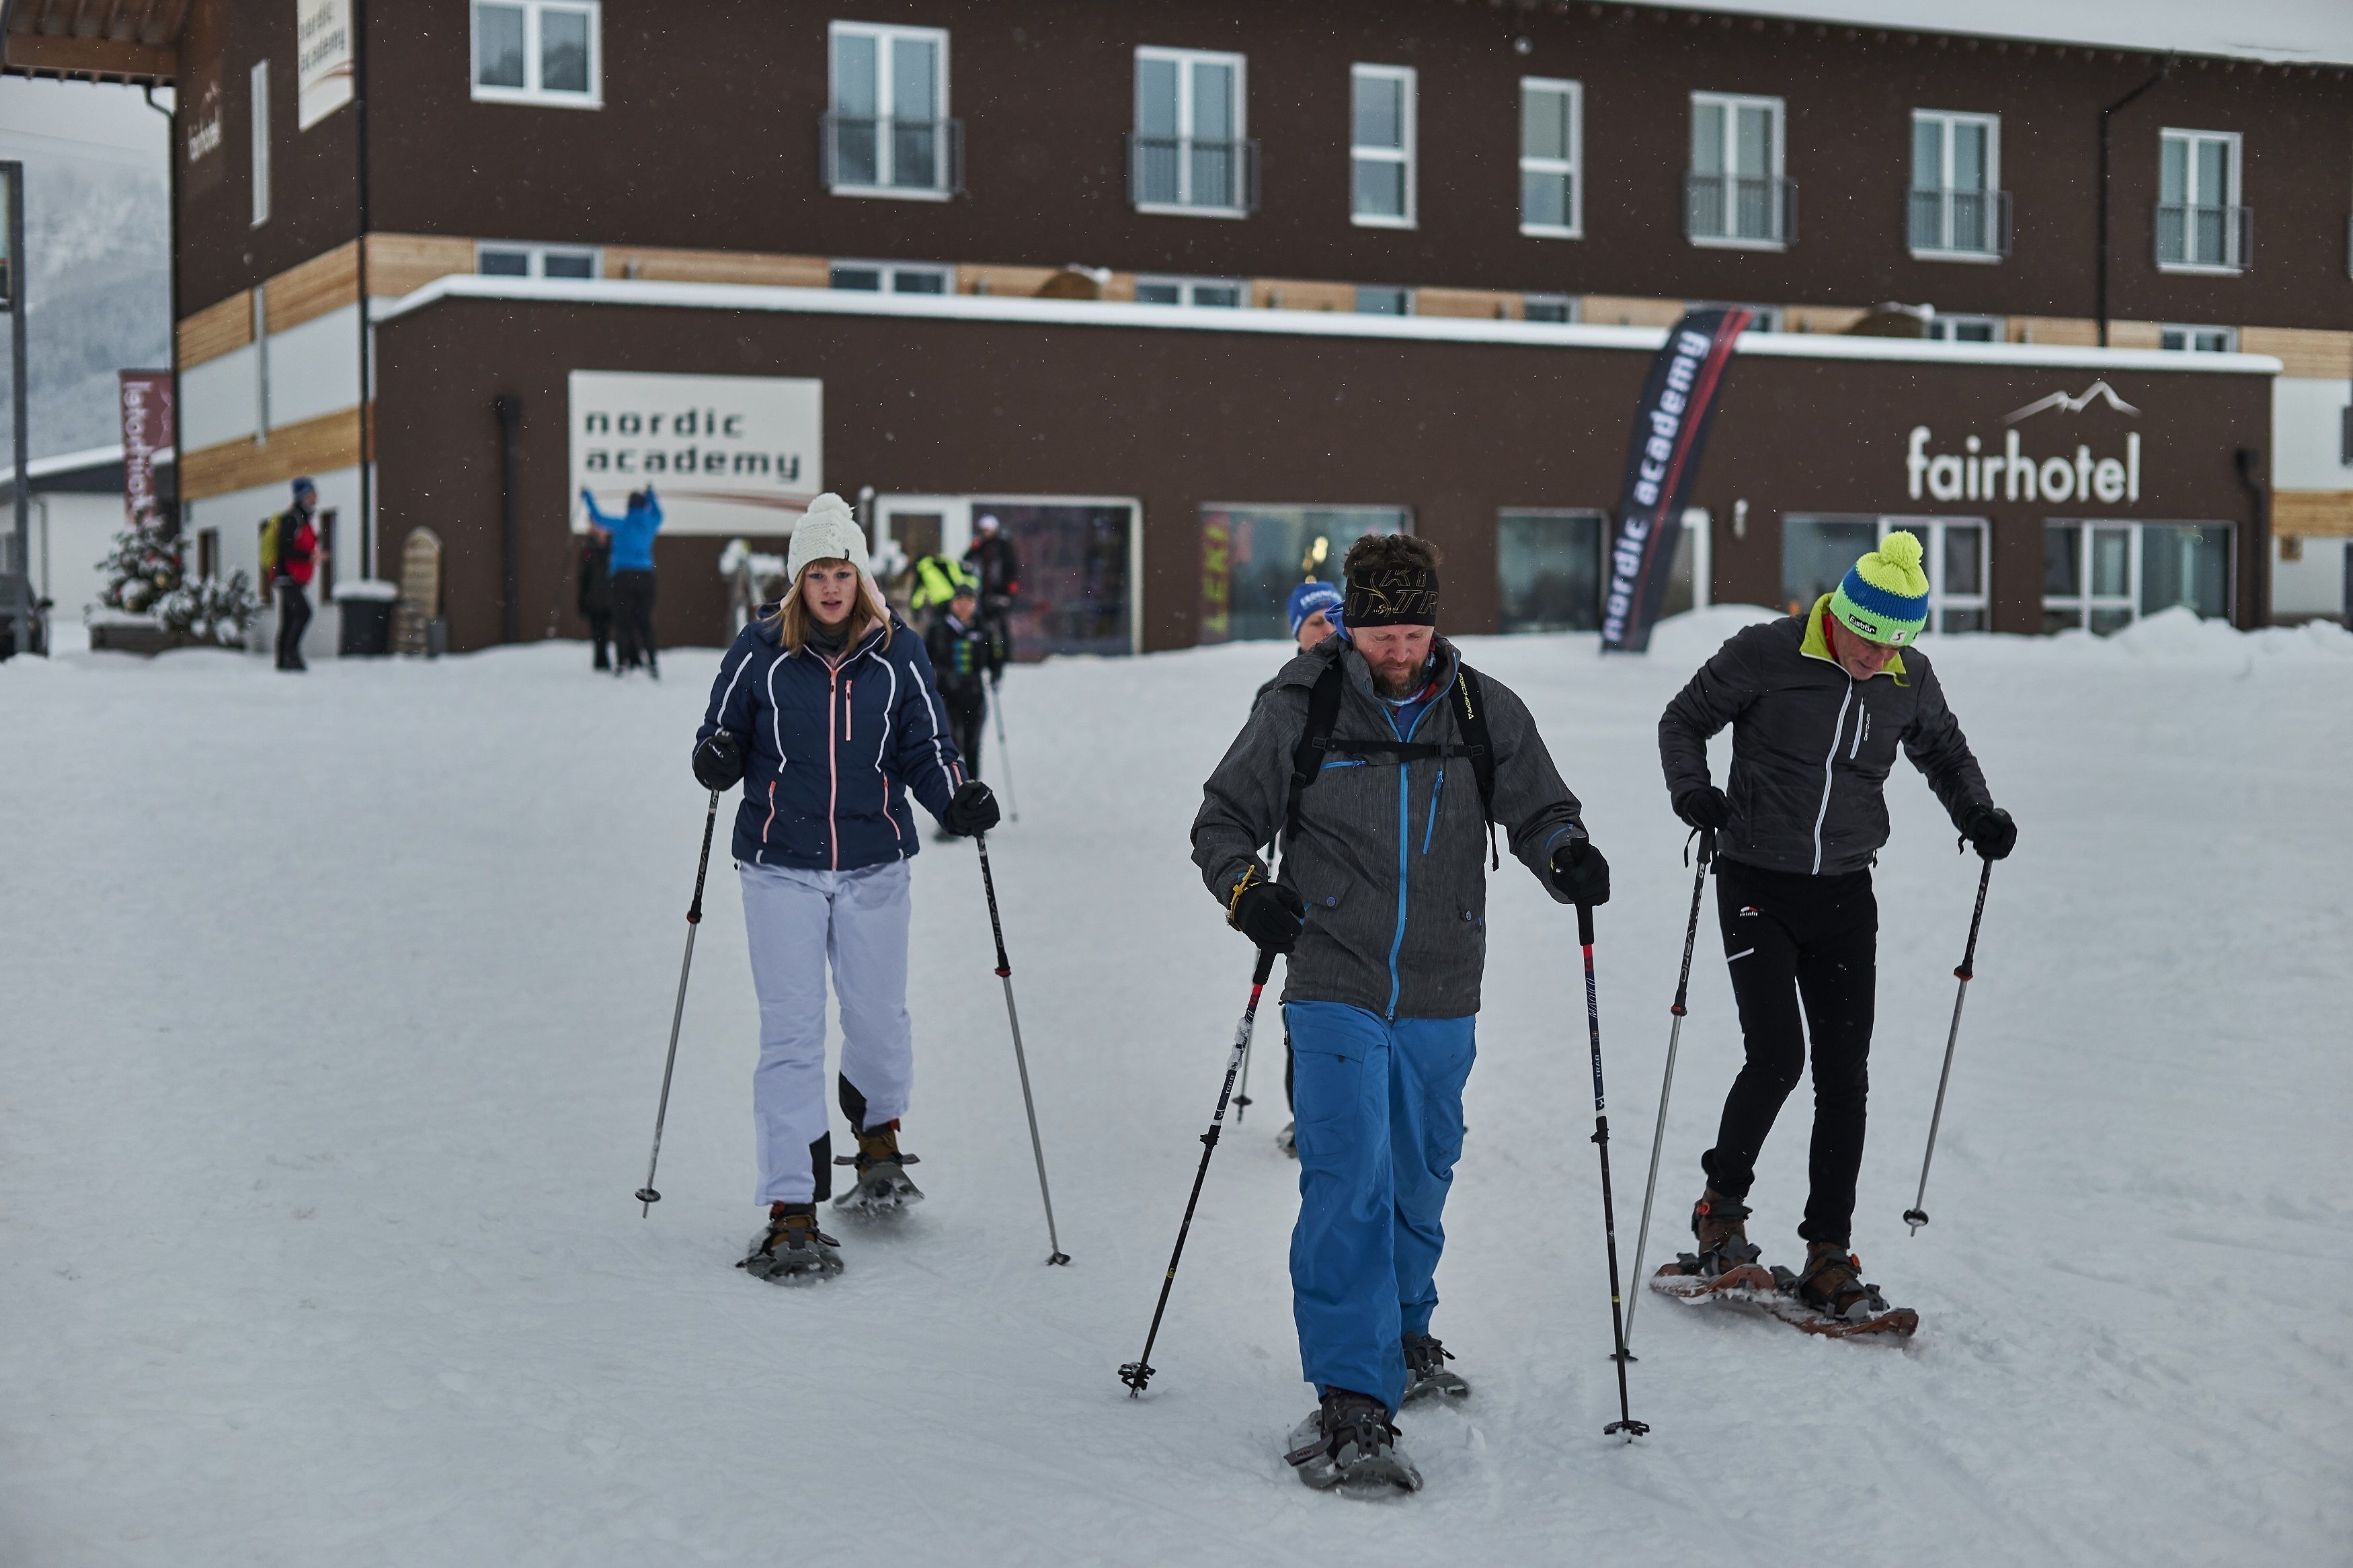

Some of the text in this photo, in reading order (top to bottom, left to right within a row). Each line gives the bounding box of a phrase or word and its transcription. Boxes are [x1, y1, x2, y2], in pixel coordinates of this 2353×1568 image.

[585, 407, 744, 438] nordic
[585, 444, 801, 484] academy
[1906, 425, 2141, 503] fairhotel
[1602, 329, 1713, 643] nordic academy
[1849, 616, 1876, 634] Eisbär
[1458, 672, 1472, 714] FISCHER
[695, 849, 709, 897] vario
[1681, 930, 1694, 983] vario
[1585, 977, 1598, 1019] MAGICO
